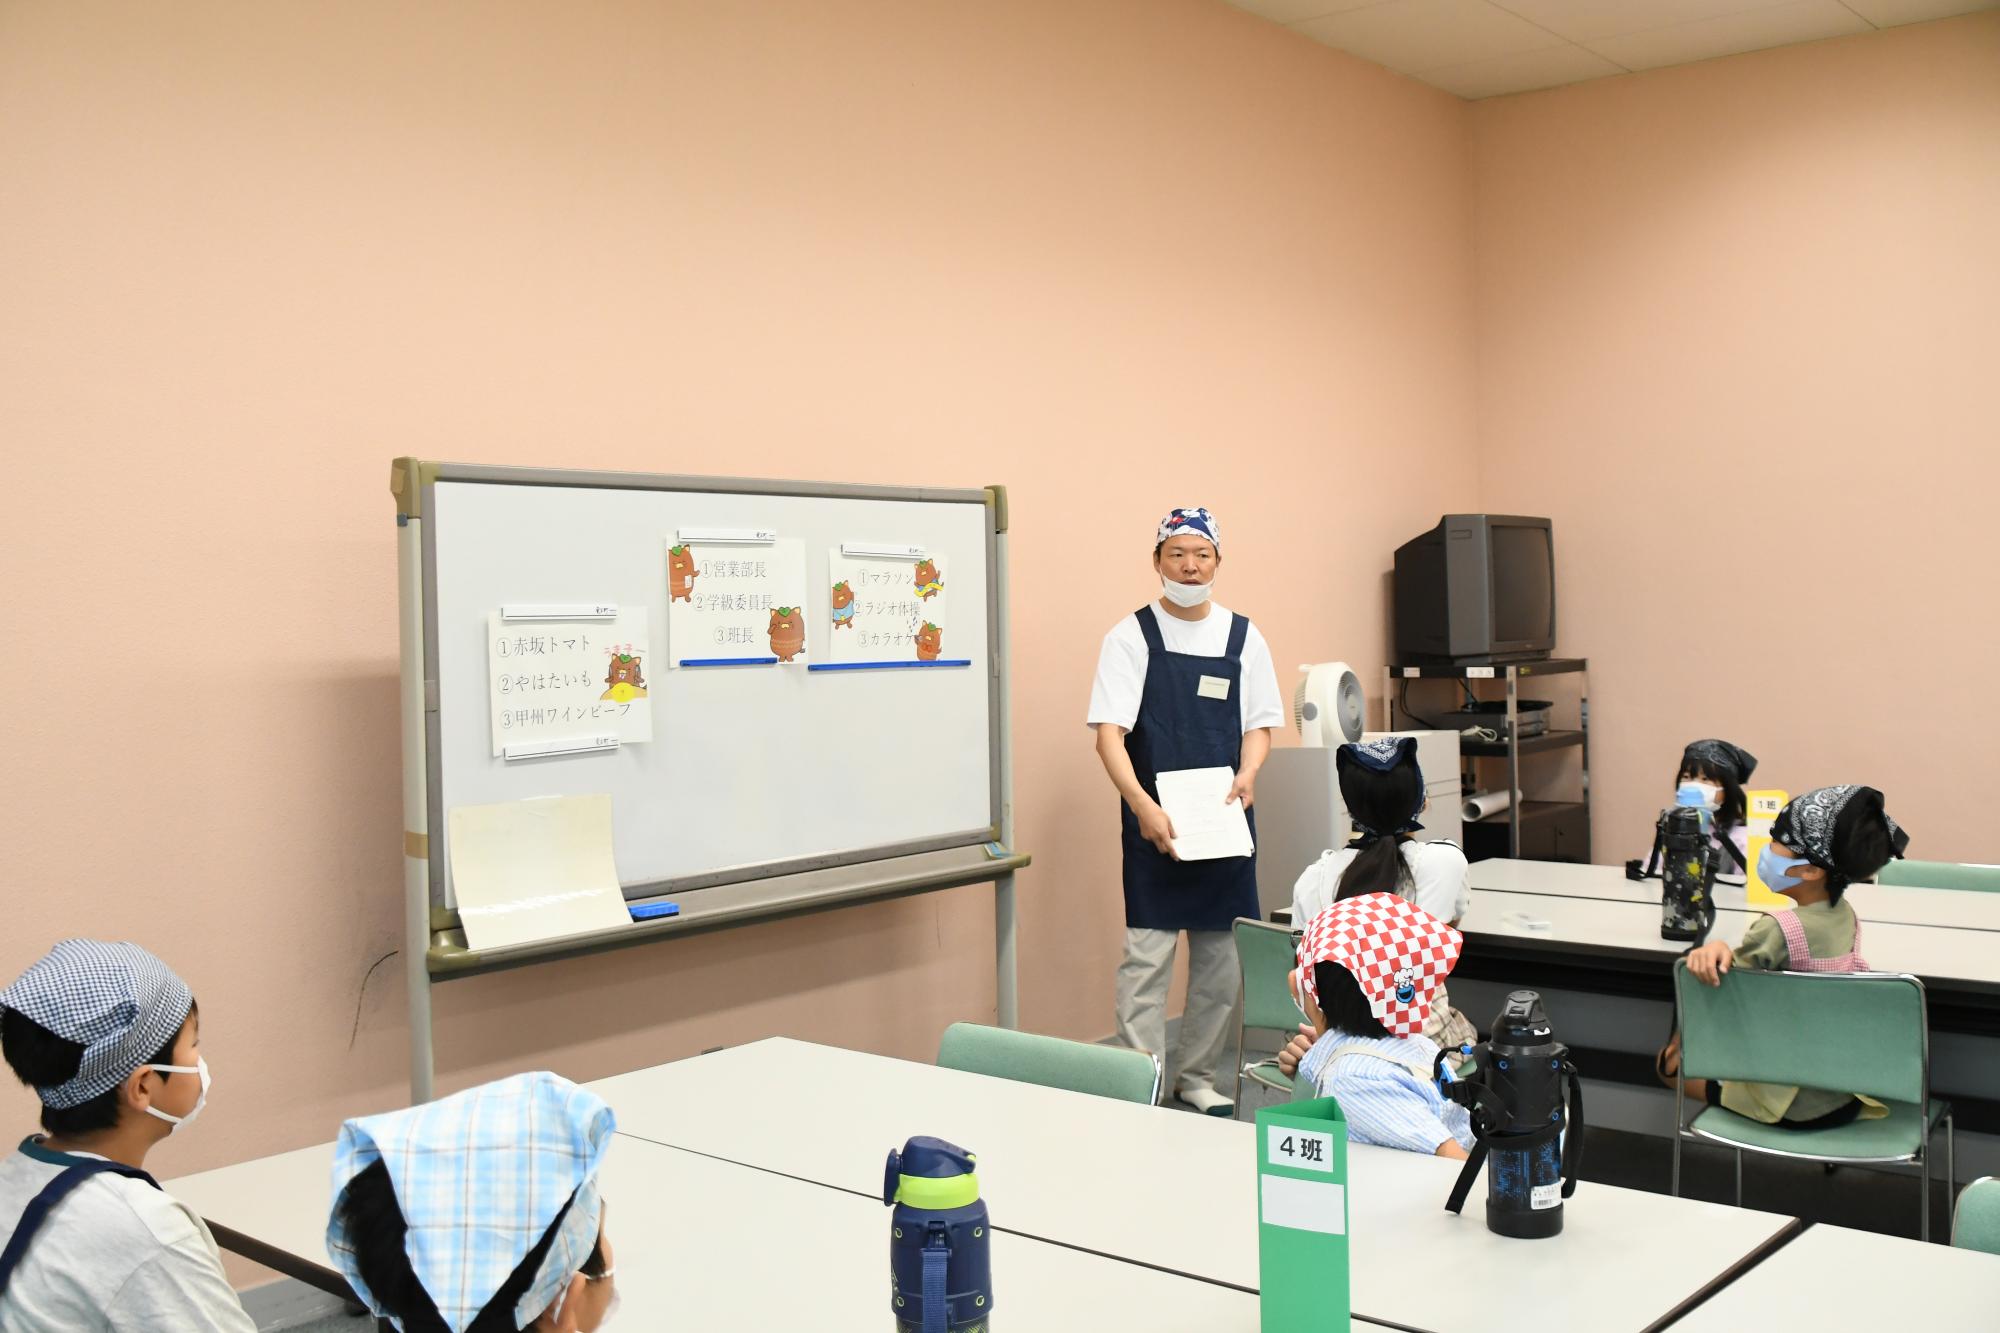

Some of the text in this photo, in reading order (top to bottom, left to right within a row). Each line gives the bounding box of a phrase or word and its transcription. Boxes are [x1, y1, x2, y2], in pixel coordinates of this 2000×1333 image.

[700, 560, 767, 579] ①営業部長
[859, 568, 914, 587] ①マラソン
[693, 592, 774, 612] ②学級委員長
[854, 600, 921, 618] ②ラジオ体操
[713, 625, 754, 645] ③班長
[858, 630, 916, 648] ③カラオケ
[496, 634, 591, 658] ①赤坂トマト
[497, 670, 592, 695] ②やはたいも
[501, 703, 632, 729] ③甲州ワインビーフ
[1279, 1135, 1324, 1162] 4班
